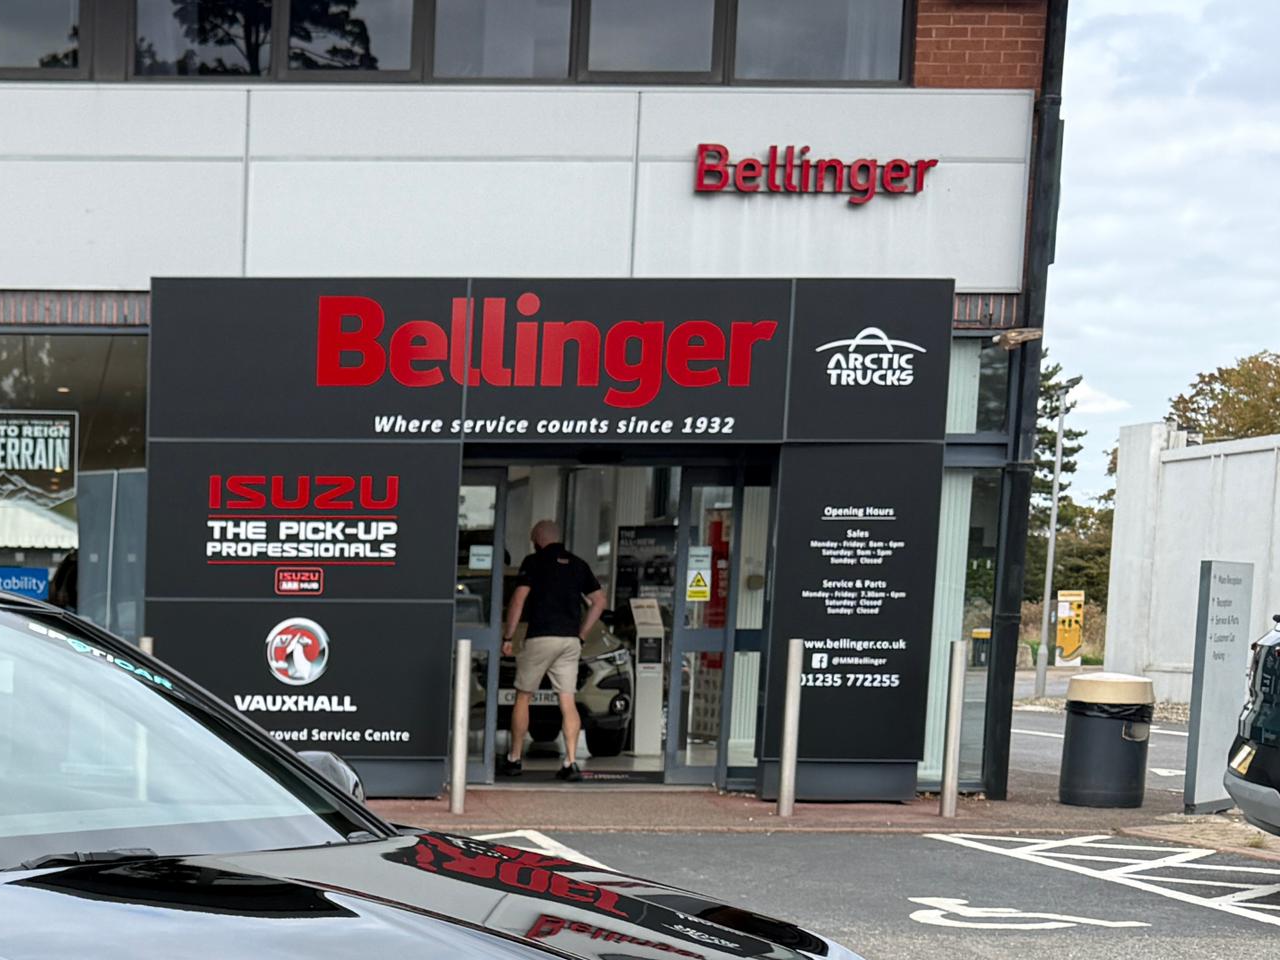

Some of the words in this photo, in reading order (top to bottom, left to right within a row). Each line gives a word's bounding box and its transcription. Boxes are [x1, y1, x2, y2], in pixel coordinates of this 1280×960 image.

[694, 143, 939, 205] Bellinger
[316, 292, 778, 409] Bellinger
[827, 352, 914, 370] ARCTIC
[827, 369, 914, 386] TRUCKS
[22, 425, 70, 438] REIGN
[374, 415, 443, 433] Where
[450, 415, 529, 434] service
[536, 416, 609, 434] counts
[616, 416, 673, 434] since
[681, 416, 735, 434] 1932
[209, 475, 400, 510] ISUZU
[824, 506, 864, 517] Opening
[866, 507, 894, 516] Hours
[207, 520, 267, 540] THE
[279, 521, 398, 541] PICK-UP
[846, 529, 869, 538] Sales
[206, 542, 397, 558] PROFESSIONALS
[279, 572, 319, 581] ISUZU
[822, 579, 853, 588] Service
[855, 580, 862, 588] &
[864, 580, 887, 588] Parts
[804, 638, 906, 651] ww.bellinger.co.uk
[832, 657, 887, 667] @MMBellinger
[846, 674, 900, 687] 772255
[234, 695, 357, 712] VAUXHALL
[311, 728, 360, 741] Service
[364, 729, 410, 742] Centre
